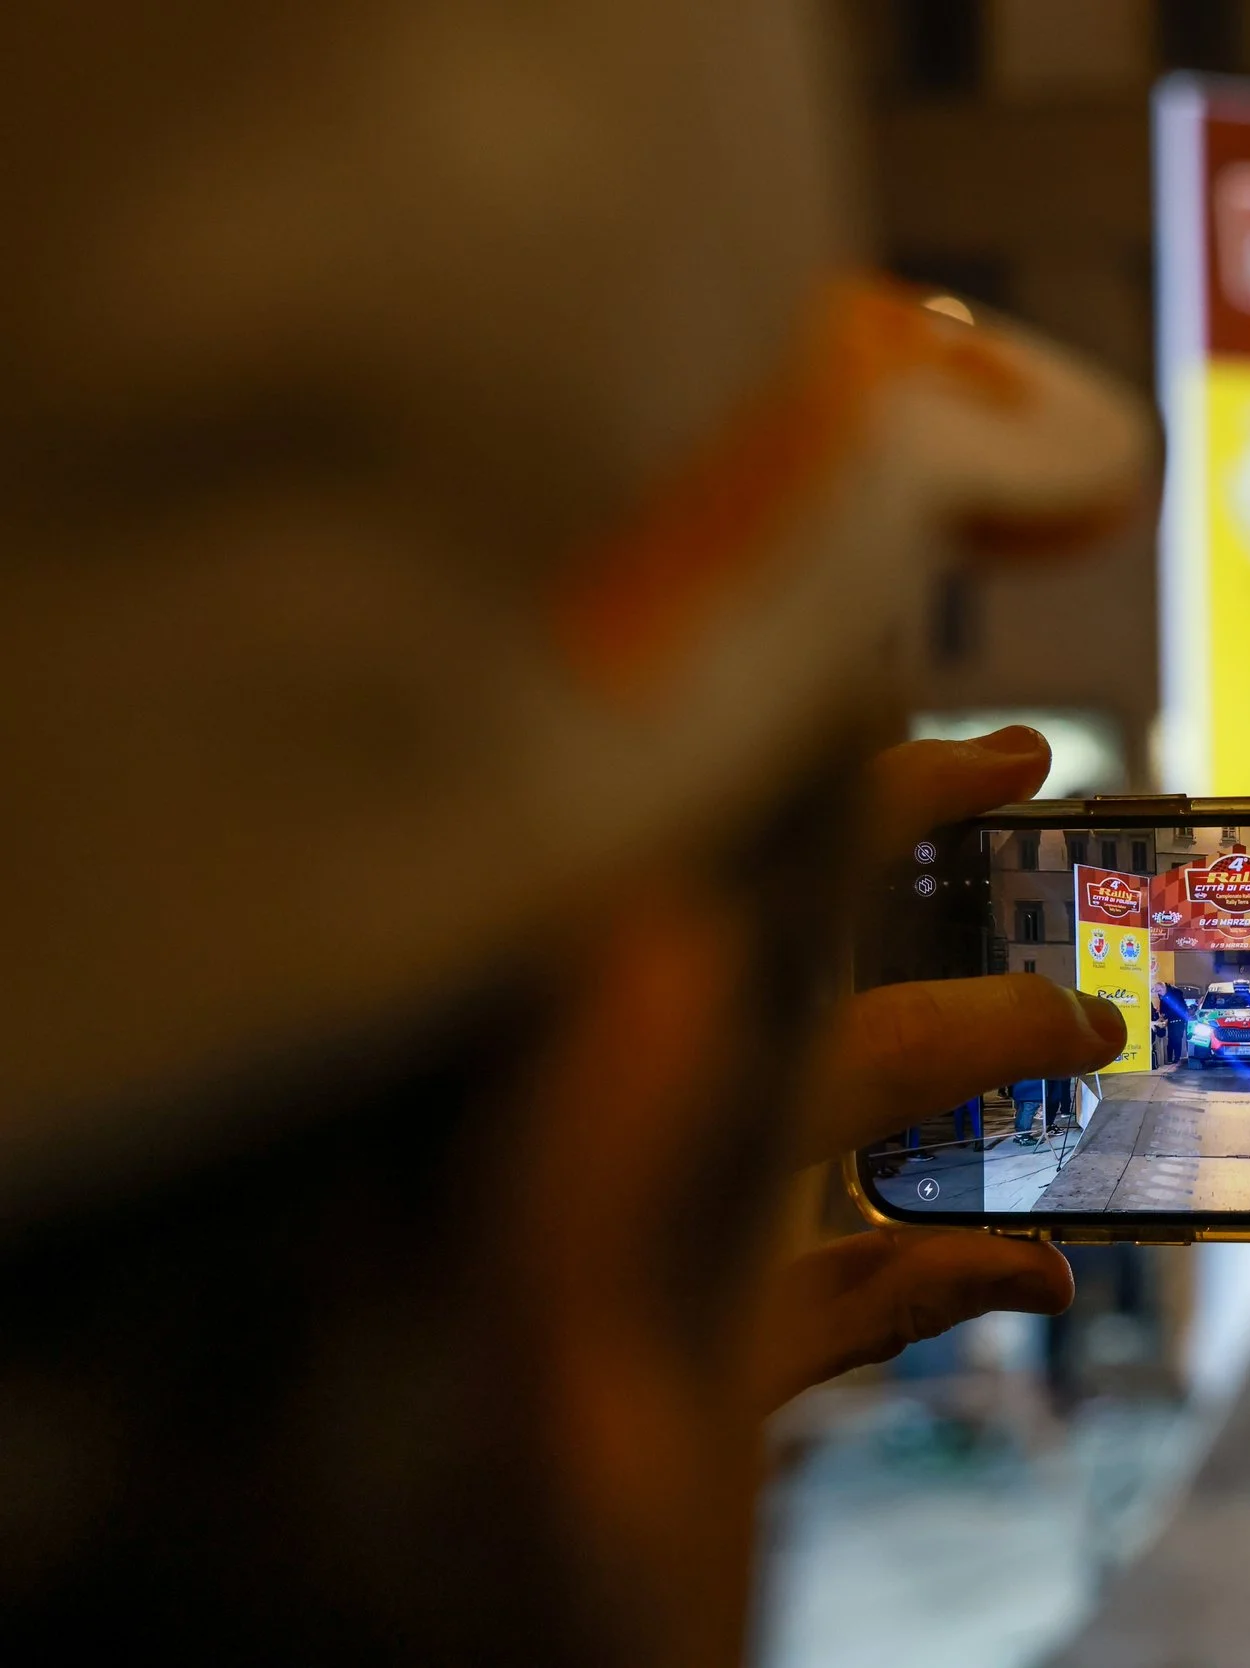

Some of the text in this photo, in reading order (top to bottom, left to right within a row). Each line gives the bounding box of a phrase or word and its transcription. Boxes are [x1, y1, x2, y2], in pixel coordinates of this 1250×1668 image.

[1195, 883, 1225, 892] CITTÀ
[1226, 884, 1237, 892] DI
[1099, 887, 1133, 901] Rally
[1220, 918, 1250, 926] MARZO
